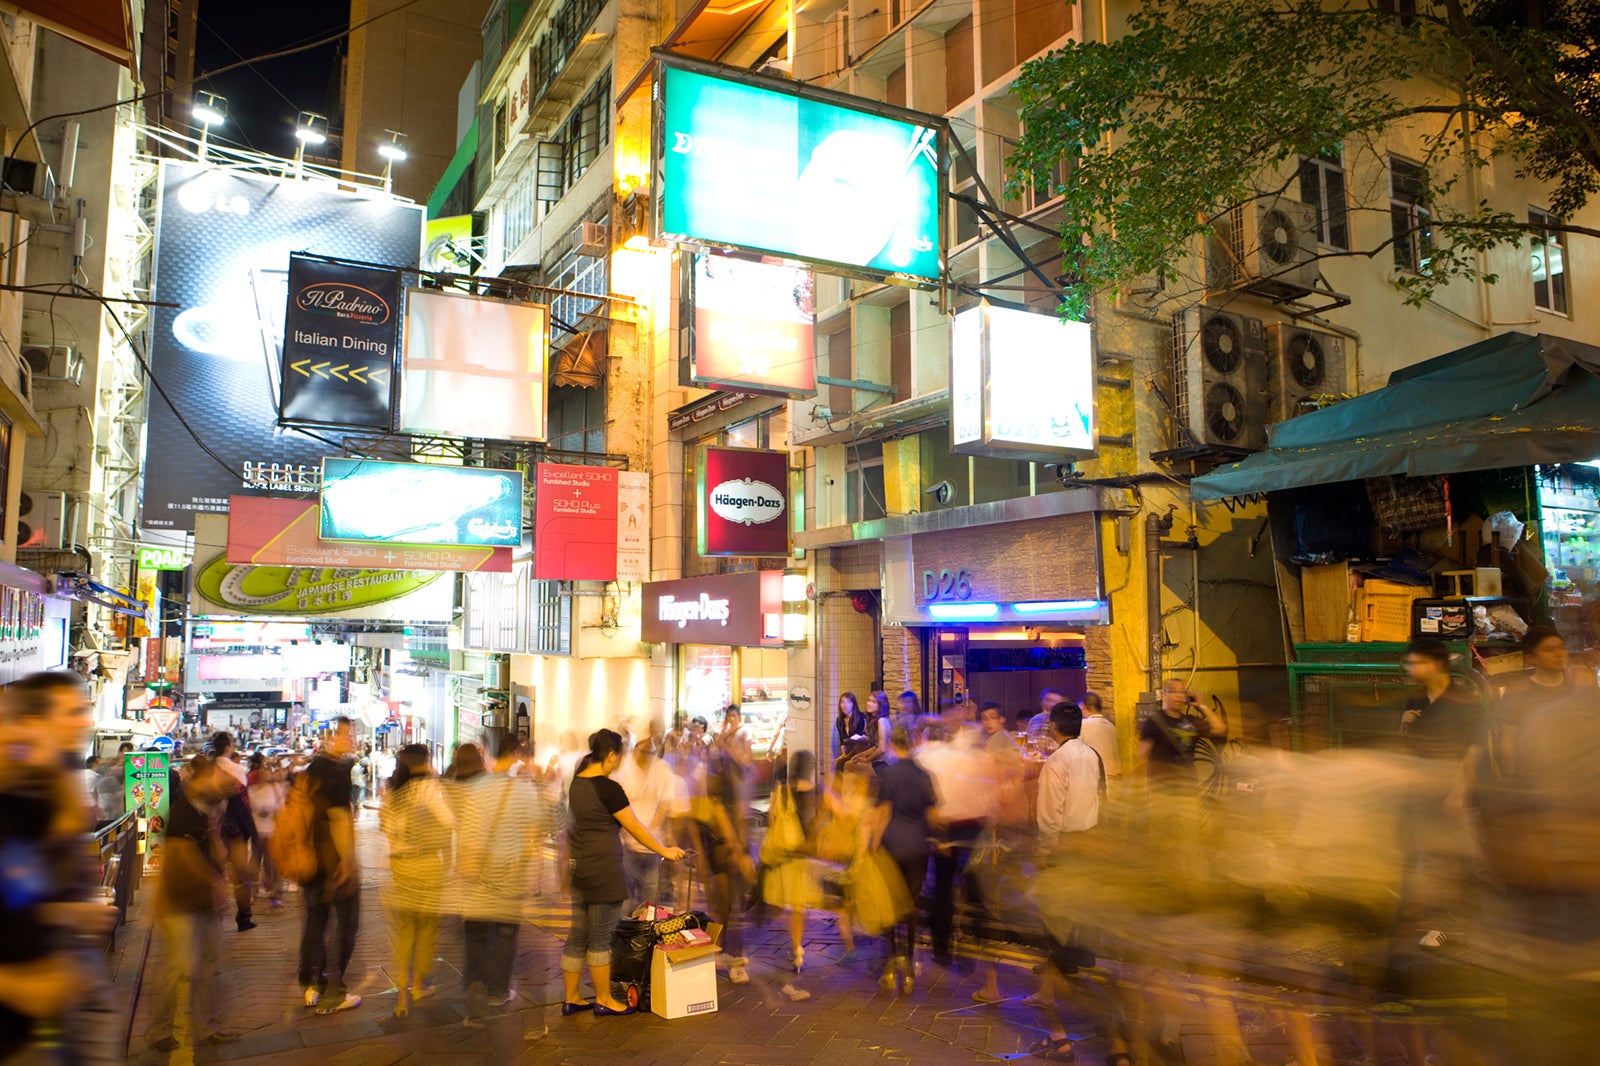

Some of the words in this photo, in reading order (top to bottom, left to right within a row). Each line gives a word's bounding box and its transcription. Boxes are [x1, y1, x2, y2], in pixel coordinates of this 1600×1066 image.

[321, 290, 382, 315] Padrino
[294, 330, 338, 347] Italian
[342, 336, 388, 356] Dining
[243, 460, 320, 484] SECRET
[543, 469, 584, 480] Excellent
[585, 471, 612, 482] SOHO
[269, 483, 293, 491] LABEL
[543, 478, 572, 486] Furnished
[571, 479, 591, 487] Studio
[553, 499, 579, 508] SOHO
[580, 500, 602, 510] Plus
[286, 545, 339, 556] Excellent
[342, 546, 378, 558] SOHO
[403, 550, 439, 561] SOHO
[441, 551, 467, 563] Plus
[286, 555, 323, 564] Furnished
[324, 556, 349, 565] Studio
[404, 560, 439, 568] Furnished
[440, 561, 462, 569] Studio
[296, 581, 345, 599] JAPANESE
[346, 570, 408, 589] RESTAURANT
[922, 567, 972, 600] D26
